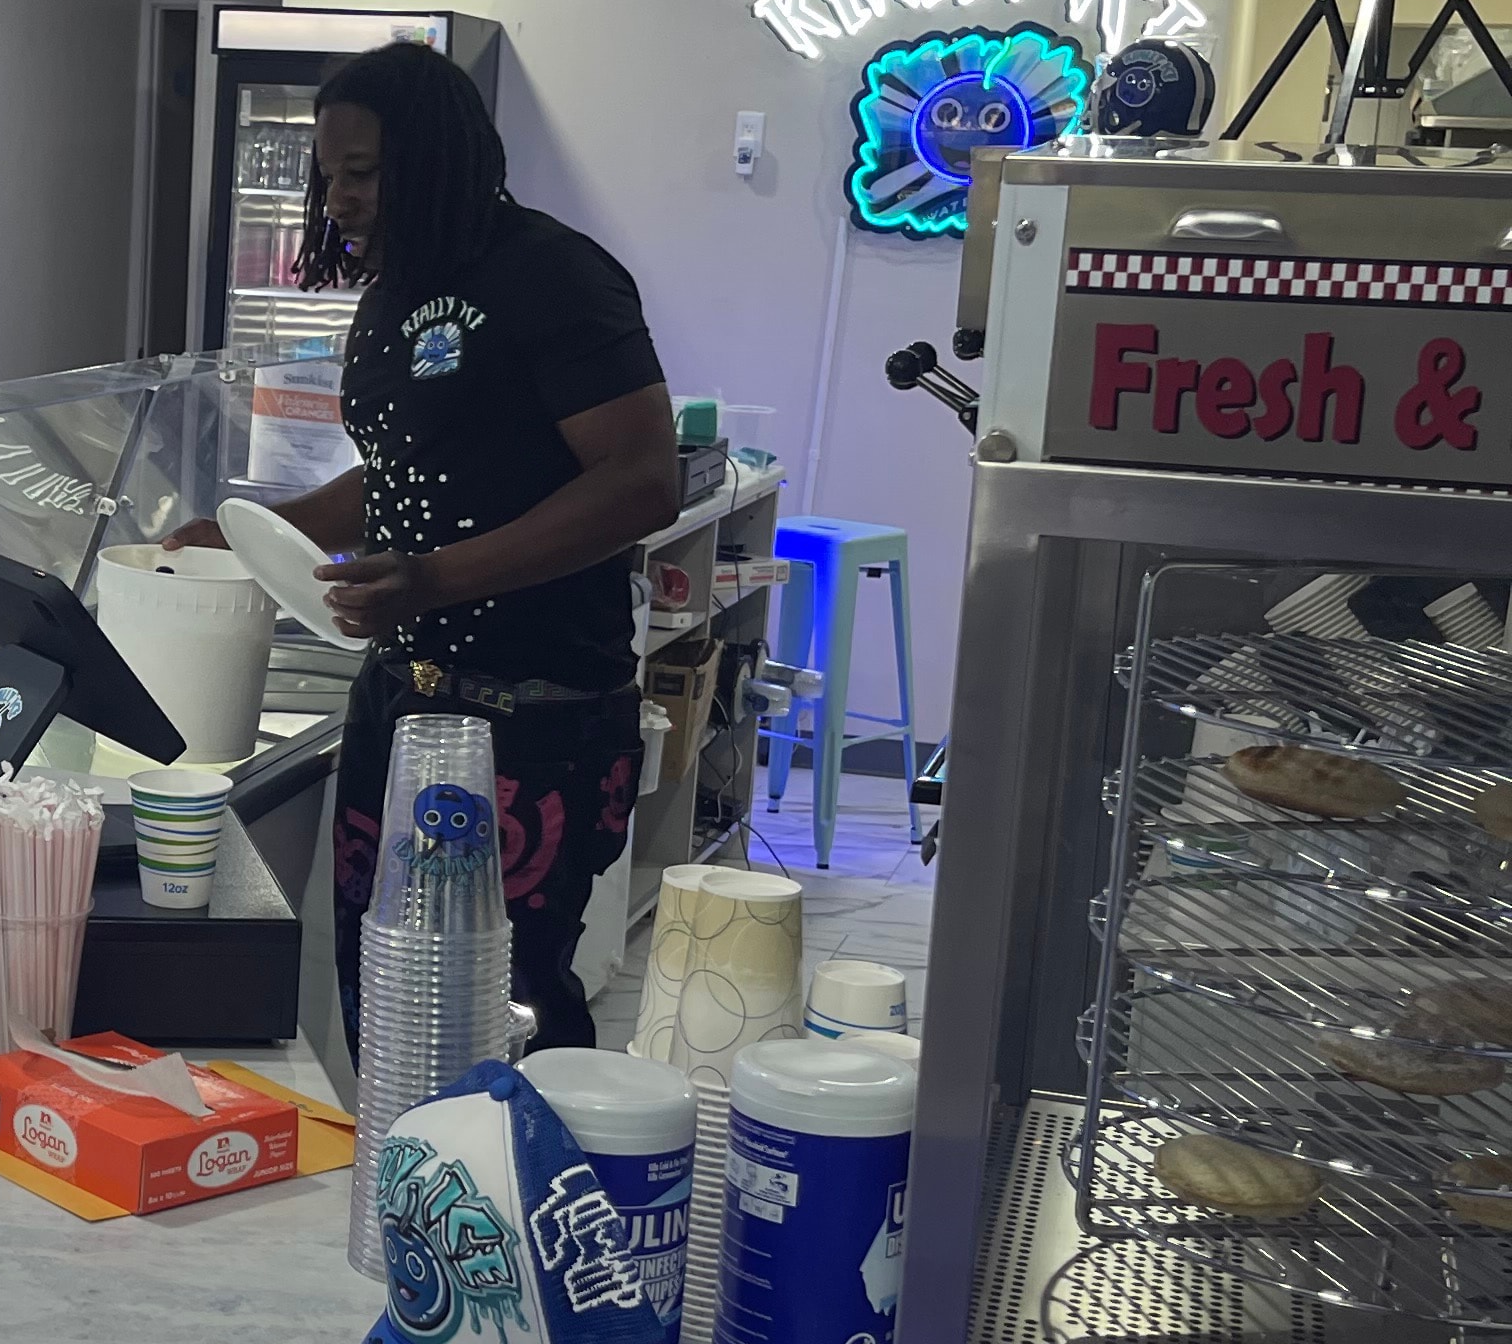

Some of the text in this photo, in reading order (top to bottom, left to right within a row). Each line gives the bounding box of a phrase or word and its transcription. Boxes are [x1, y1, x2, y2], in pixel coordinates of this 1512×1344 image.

[400, 296, 455, 338] REALLY
[1088, 322, 1482, 450] Fresh &
[162, 881, 189, 894] 12oz
[21, 1115, 69, 1155] Logan
[196, 1149, 251, 1177] Logan
